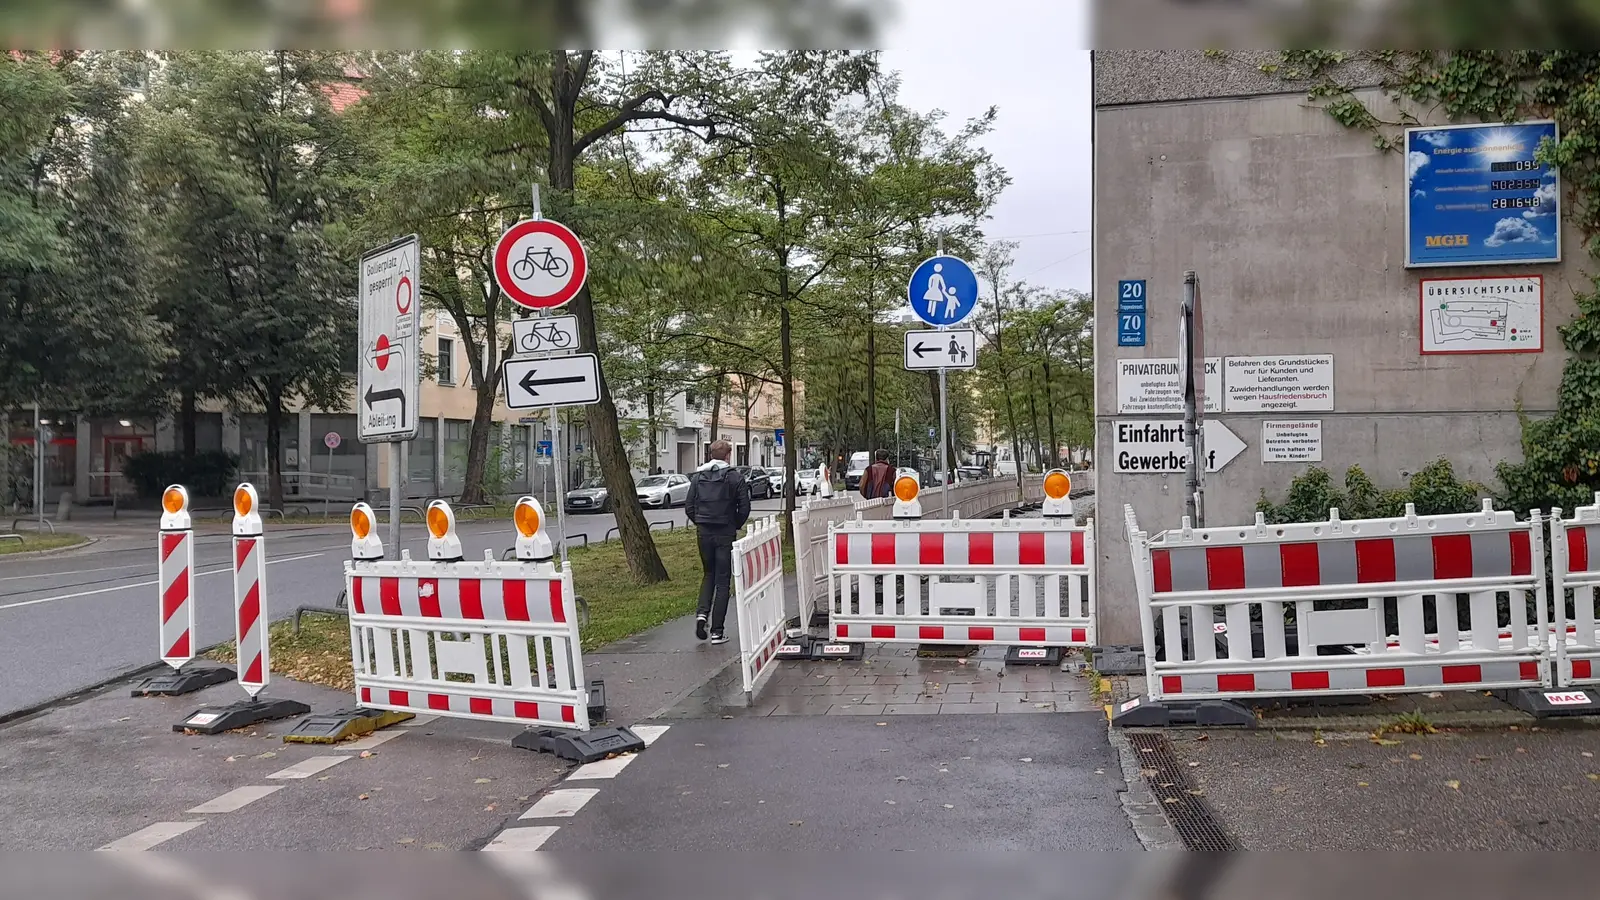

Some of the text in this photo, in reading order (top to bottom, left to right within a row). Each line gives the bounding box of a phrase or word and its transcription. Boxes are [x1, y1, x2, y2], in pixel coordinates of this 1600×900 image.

[1433, 147, 1463, 156] Energie
[1492, 179, 1540, 190] 402354
[1492, 197, 1540, 209] 281648
[1425, 234, 1469, 247] MGH
[366, 256, 397, 277] Gollierplatz
[369, 273, 393, 296] gesperrt
[1122, 282, 1142, 298] 20
[1428, 285, 1534, 296] ÜBERSICHTSPLAN
[1122, 315, 1141, 330] 70
[1262, 359, 1277, 367] des
[1278, 358, 1330, 366] Grundstückes
[1122, 362, 1217, 376] PRIVATGRUNCK
[1144, 388, 1172, 396] Fahrzeugen
[1229, 385, 1301, 393] Zuwiderhandlungen
[1232, 394, 1257, 402] wegen
[1261, 401, 1298, 409] angezeigt.
[1118, 424, 1185, 442] Einfahrt
[1118, 450, 1216, 470] Gewerbef
[1548, 694, 1586, 702] MAC
